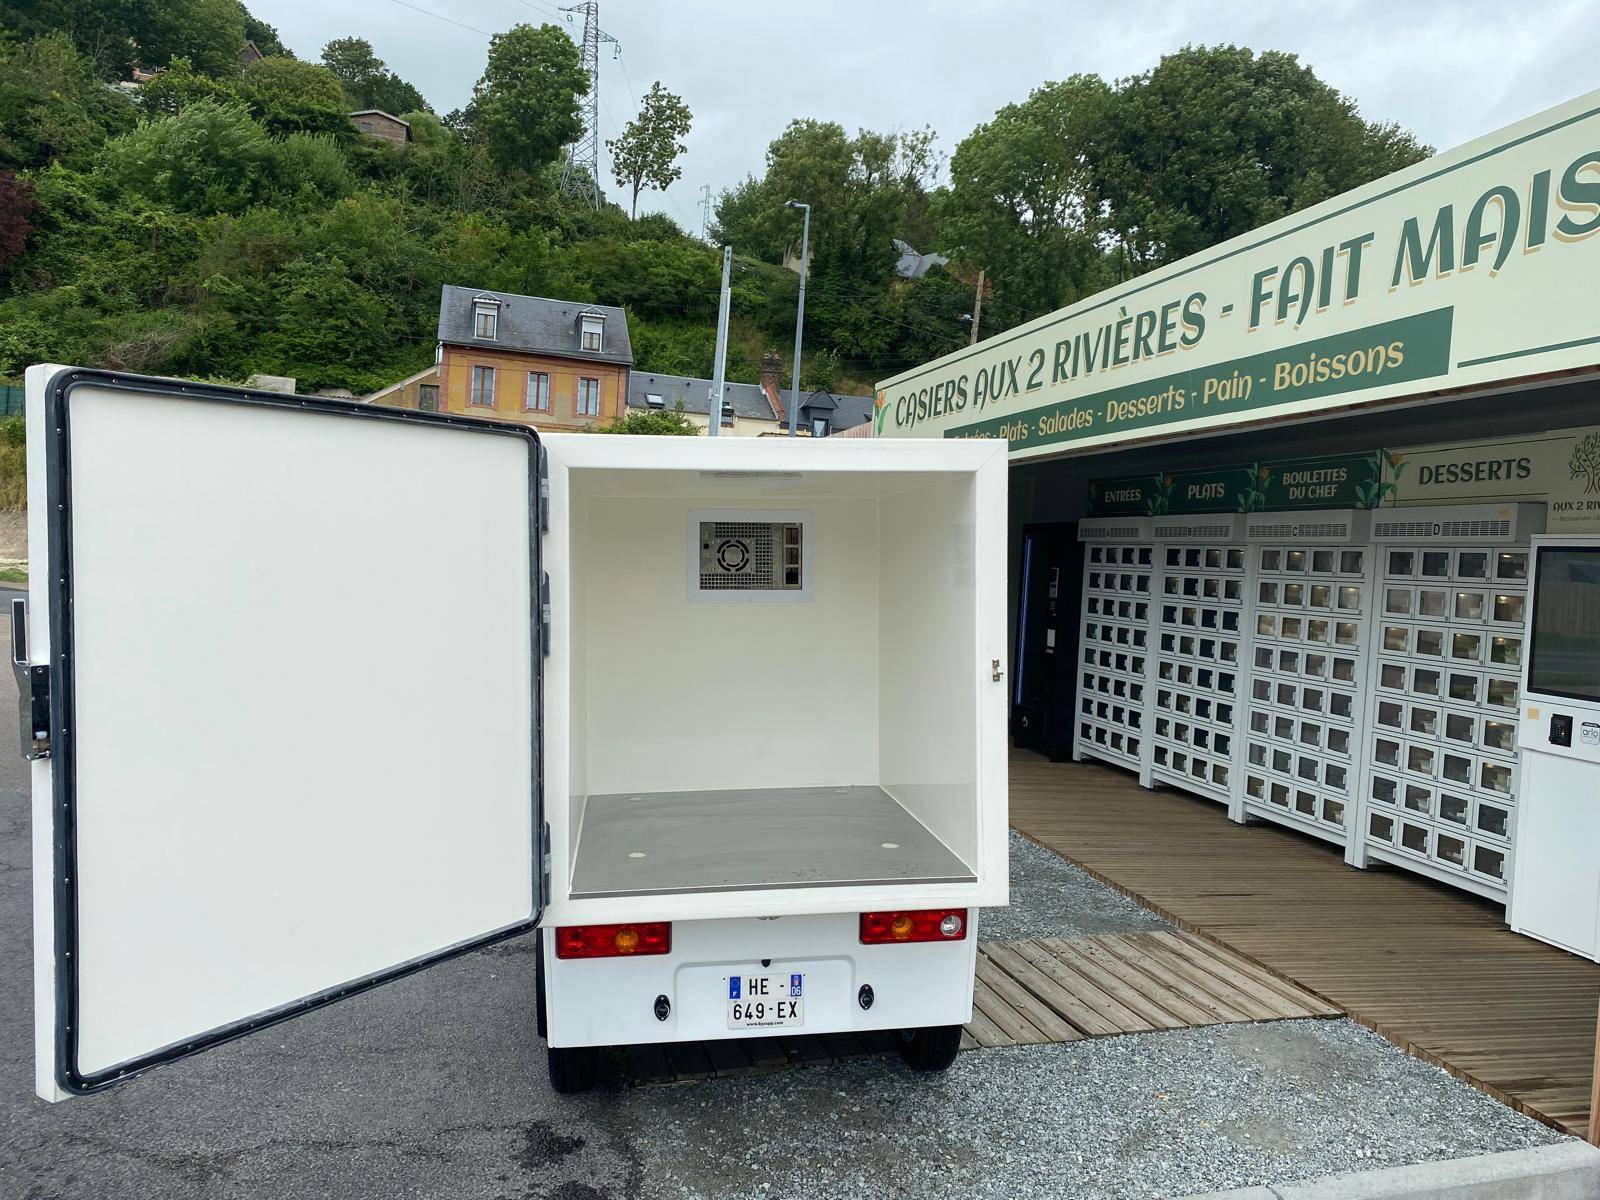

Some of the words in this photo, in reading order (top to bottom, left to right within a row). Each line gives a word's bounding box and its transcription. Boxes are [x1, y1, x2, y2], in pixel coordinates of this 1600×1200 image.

[895, 375, 968, 430] CASIERS
[973, 356, 1022, 413] AUX
[1026, 348, 1046, 393] 2
[1051, 292, 1208, 384] RIVIÈRES
[1247, 232, 1374, 332] FAIT
[1038, 407, 1094, 437] Salades
[1106, 384, 1186, 424] Desserts
[1203, 373, 1253, 406] Pain
[1273, 340, 1405, 392] Boissons
[1282, 467, 1348, 485] BOULETTES
[1418, 457, 1531, 485] DESSERTS
[1104, 488, 1142, 503] ENTRÉES
[1187, 482, 1225, 500] PLATS
[1289, 487, 1305, 500] DU
[1308, 484, 1339, 499] CHEF
[1552, 501, 1574, 512] AUX
[1576, 501, 1584, 511] 2
[1105, 529, 1111, 538] A
[1187, 527, 1193, 537] B
[1292, 526, 1298, 537] C
[1433, 524, 1441, 536] D
[749, 978, 769, 995] HE
[791, 986, 802, 995] 06
[733, 1001, 798, 1020] 649-EX
